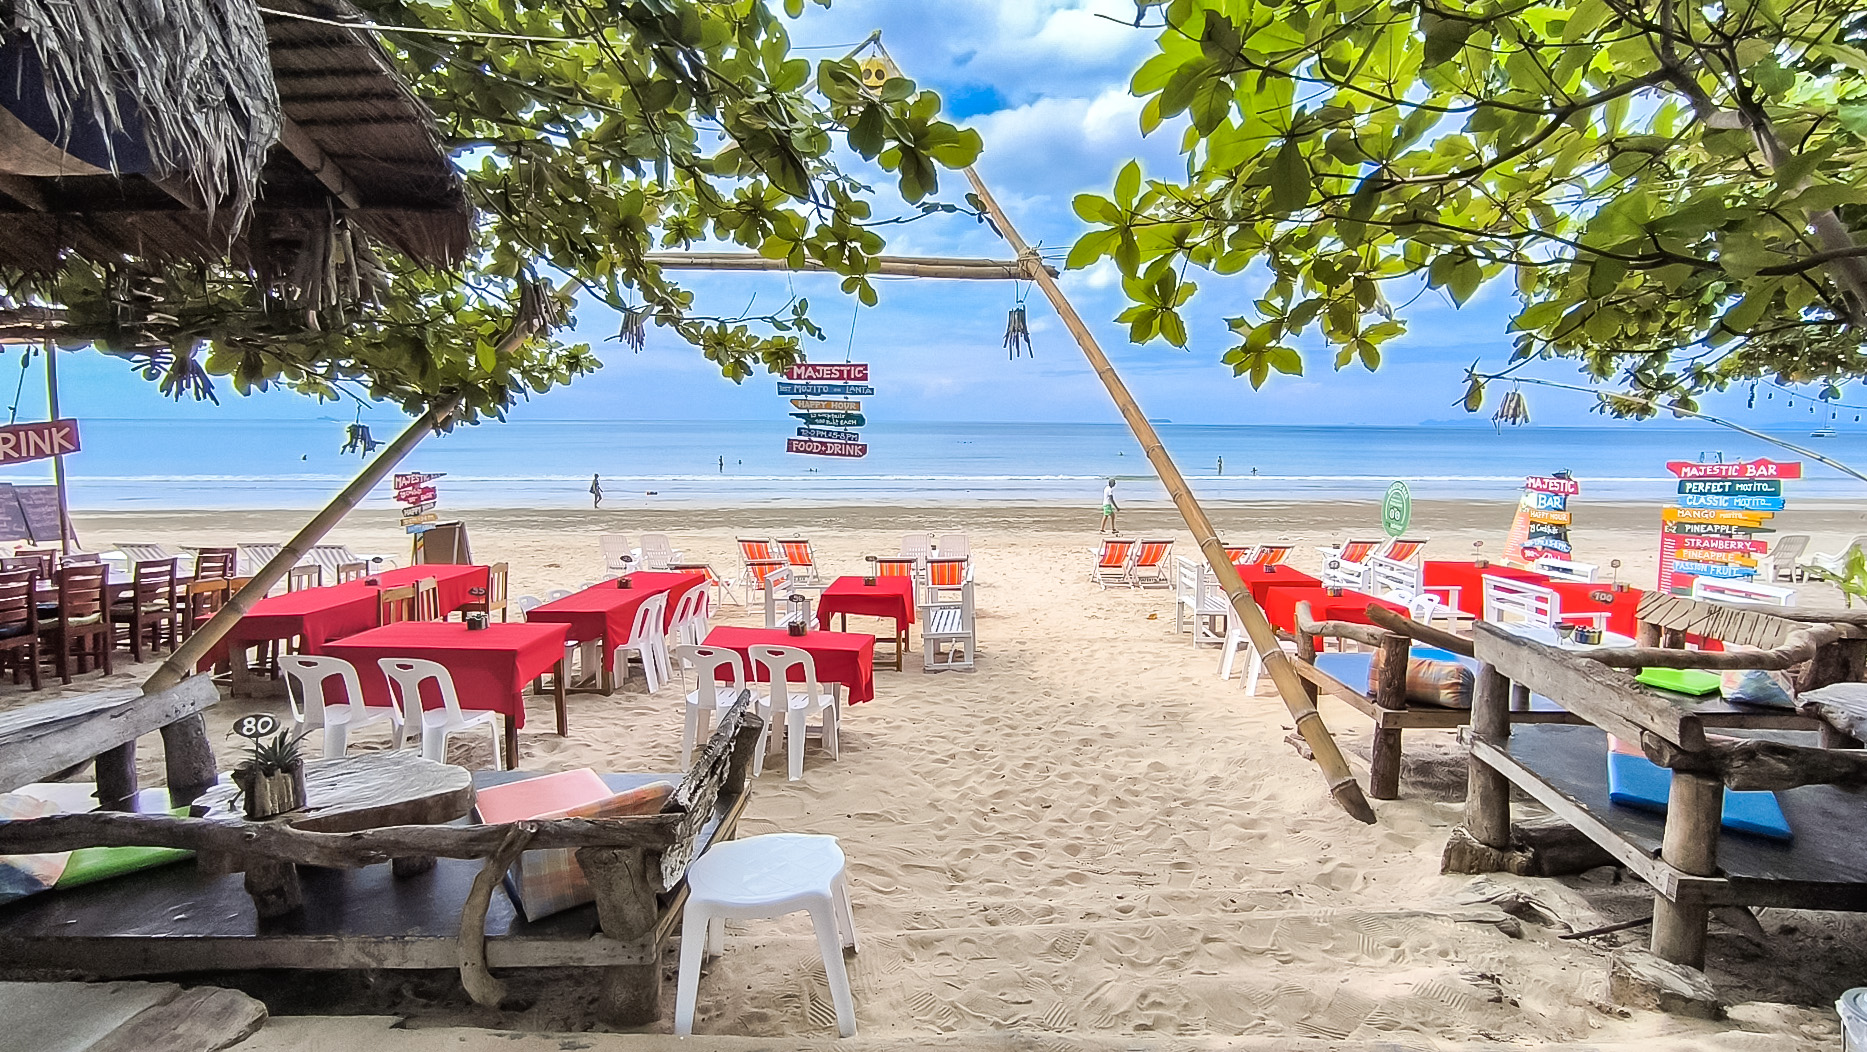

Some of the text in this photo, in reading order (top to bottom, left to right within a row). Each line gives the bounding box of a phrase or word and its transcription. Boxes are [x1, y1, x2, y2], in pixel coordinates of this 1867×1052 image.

[793, 366, 865, 379] MAJESTIC
[846, 386, 872, 394] LANTA
[798, 401, 856, 410] HAPPY HOUR
[1681, 464, 1777, 477] MAJESTIC BAR
[395, 474, 430, 489] MAJESTIC
[1528, 477, 1575, 492] MAJESTIC
[1685, 482, 1732, 493] PERFECT
[1538, 494, 1562, 508] BAR
[1687, 495, 1729, 507] CLASSIC
[1677, 509, 1716, 519] MANGO
[1674, 562, 1707, 571] PASSION
[1595, 592, 1613, 602] 100
[242, 716, 273, 735] 80
